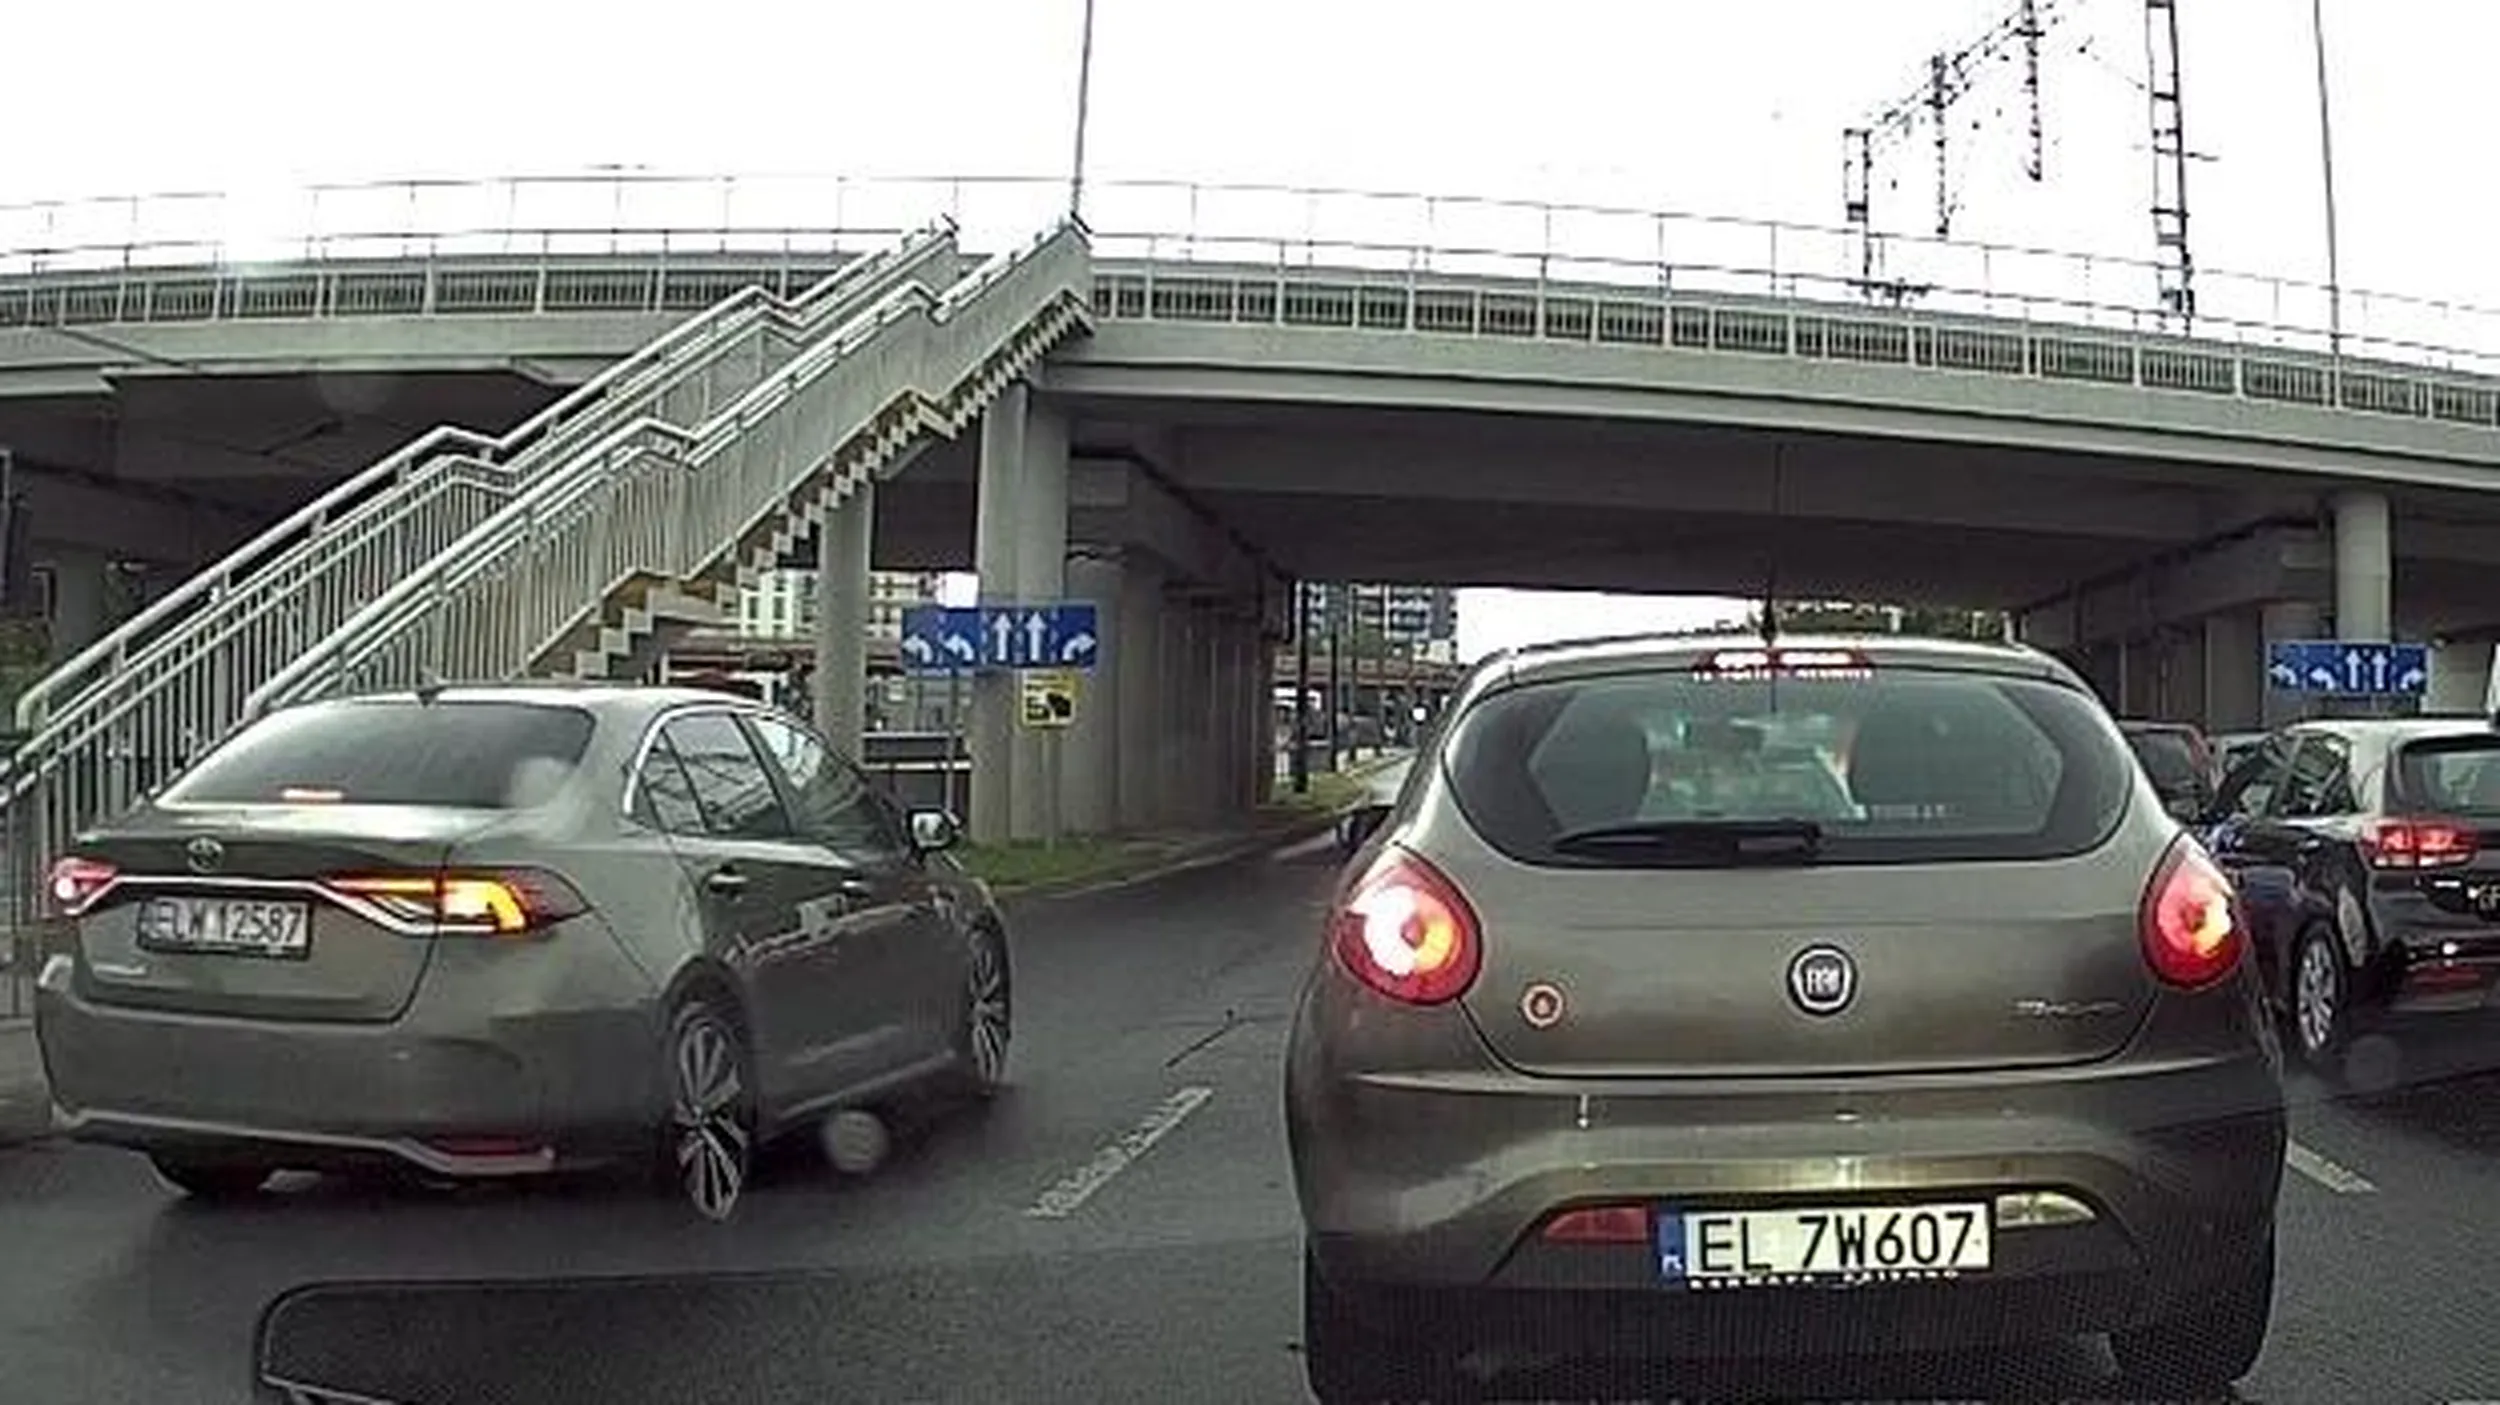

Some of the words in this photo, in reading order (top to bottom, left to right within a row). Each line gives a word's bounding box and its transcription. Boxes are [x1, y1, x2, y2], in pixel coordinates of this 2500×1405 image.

[219, 904, 304, 942] 12587
[1701, 1217, 1771, 1272] EL
[1798, 1211, 1974, 1269] 7W607
